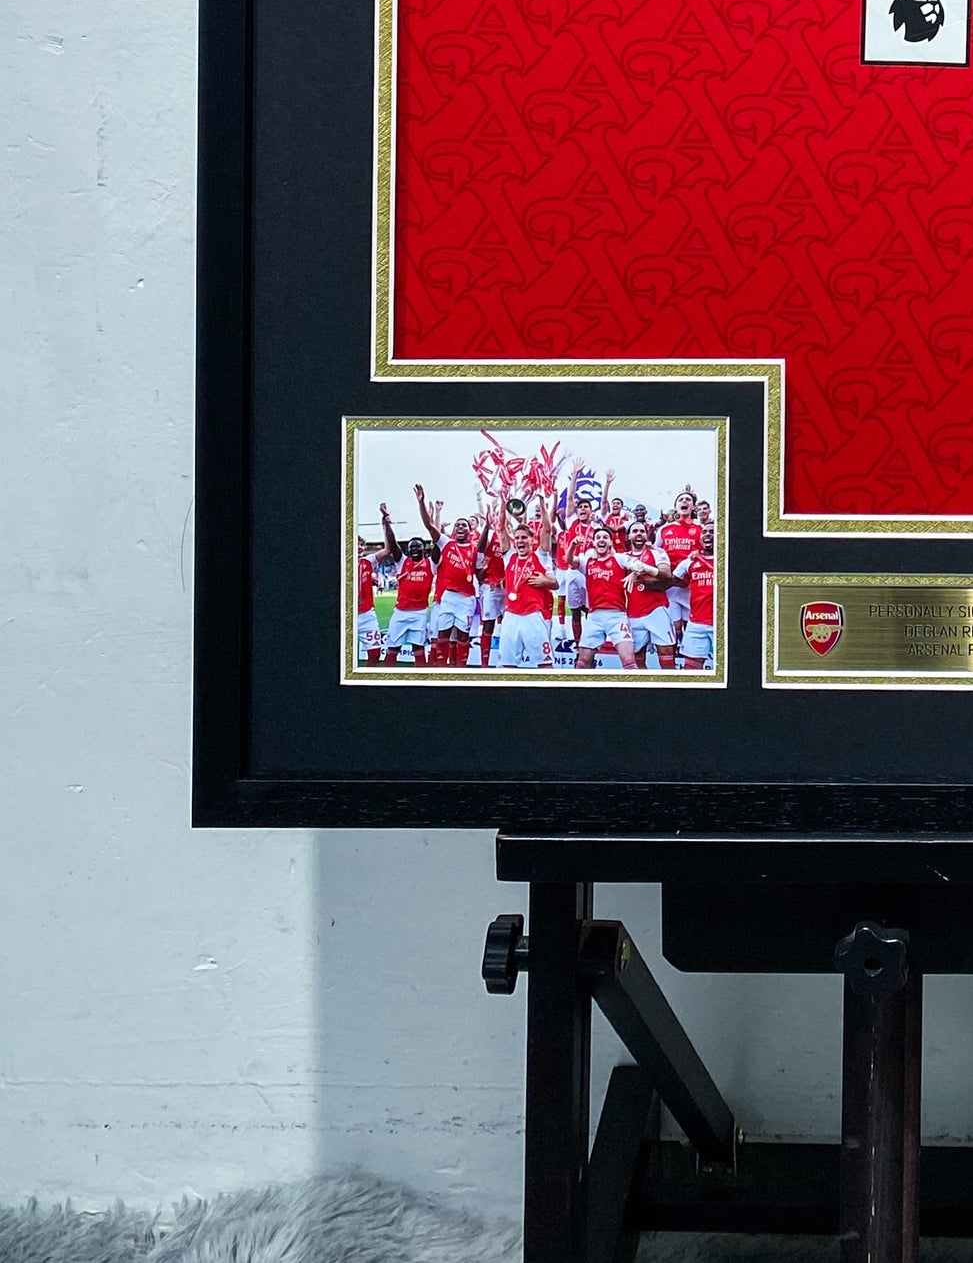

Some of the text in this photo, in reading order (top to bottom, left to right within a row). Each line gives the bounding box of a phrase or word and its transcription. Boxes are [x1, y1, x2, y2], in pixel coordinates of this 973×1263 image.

[805, 610, 839, 621] Arsenal
[869, 604, 954, 618] PERSONALLY
[366, 631, 381, 642] 56
[904, 625, 958, 638] DECLAN
[542, 641, 551, 655] 8
[907, 643, 965, 656] ARSENAL
